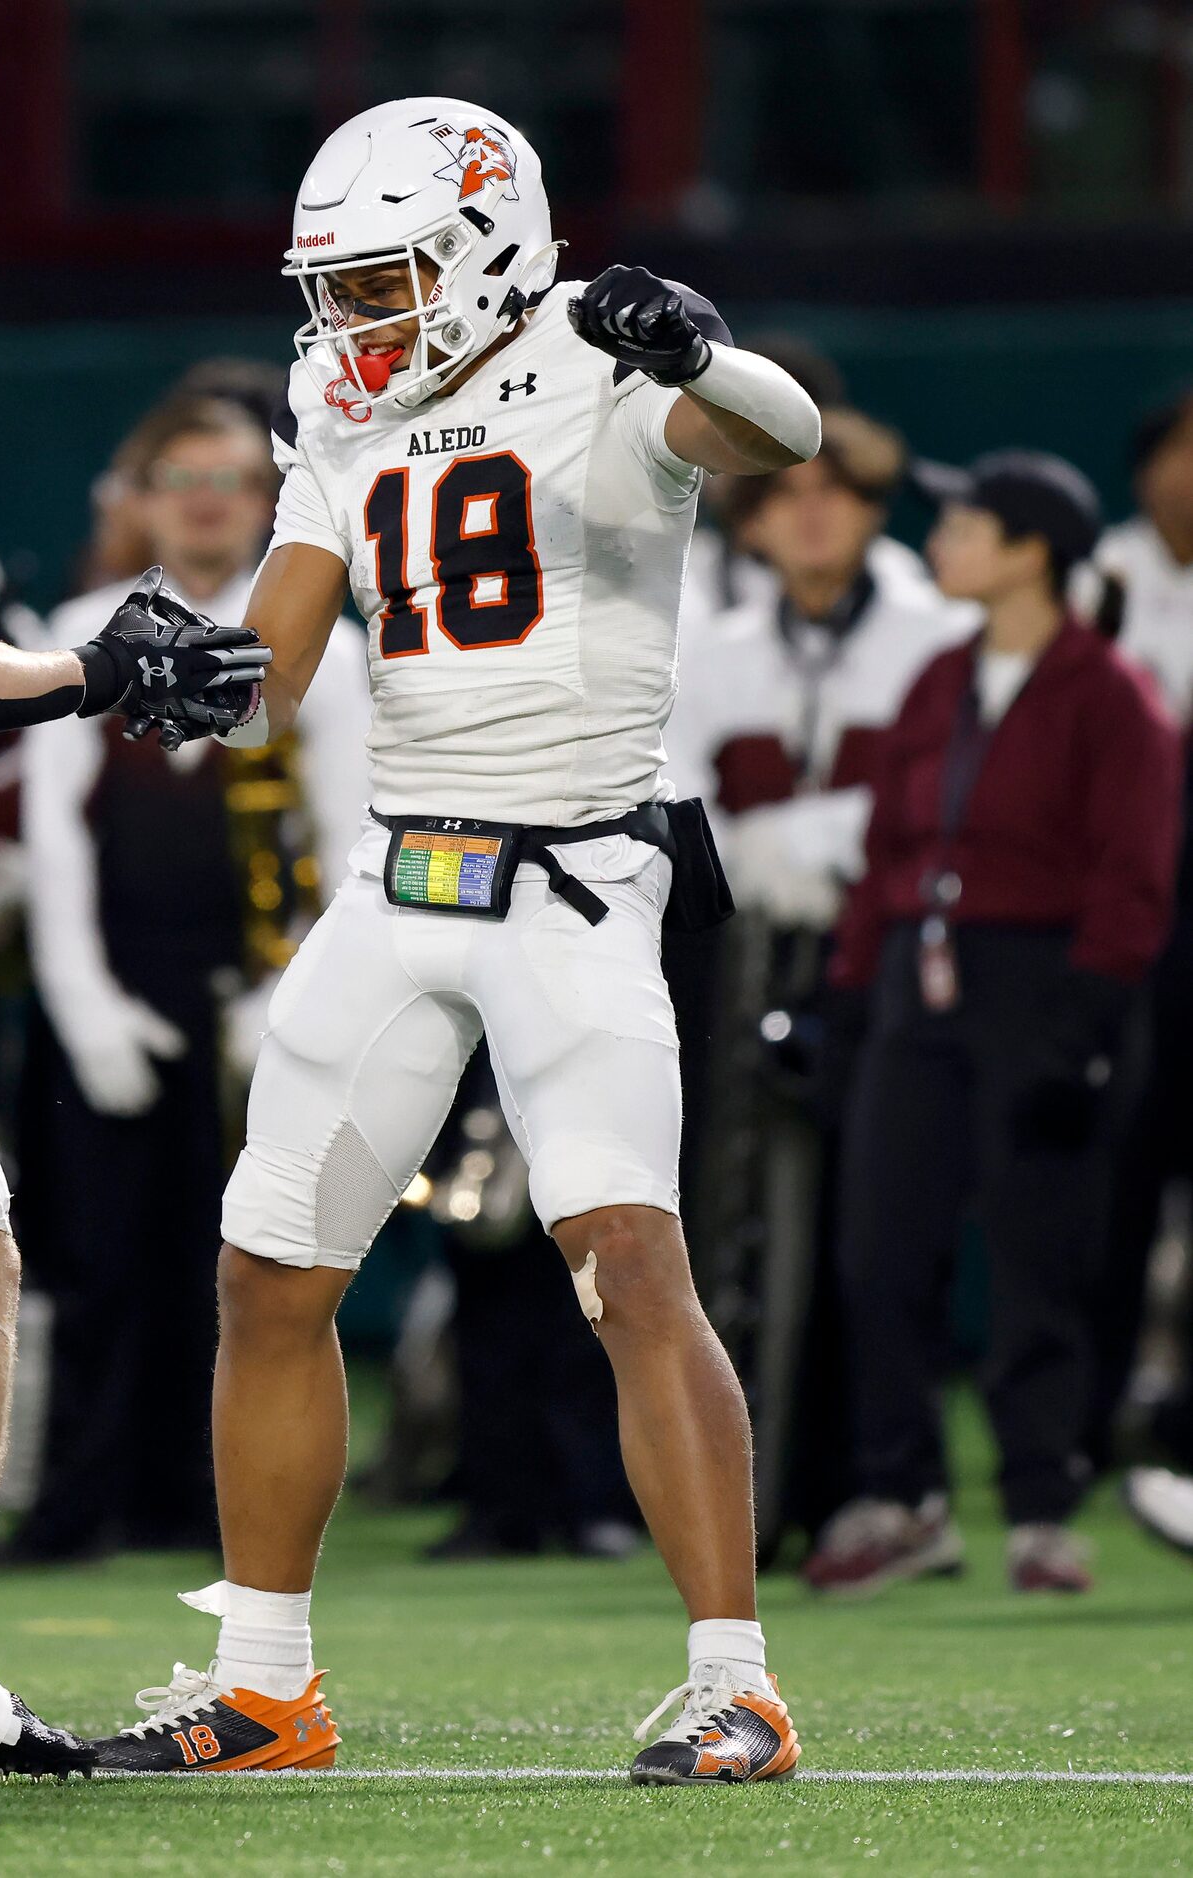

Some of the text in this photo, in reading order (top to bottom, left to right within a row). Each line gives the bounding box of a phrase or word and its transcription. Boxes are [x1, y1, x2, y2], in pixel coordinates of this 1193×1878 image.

[296, 232, 335, 249] Riddell
[407, 425, 486, 457] ALEDO
[363, 449, 545, 660] 18
[170, 1724, 222, 1766] 18
